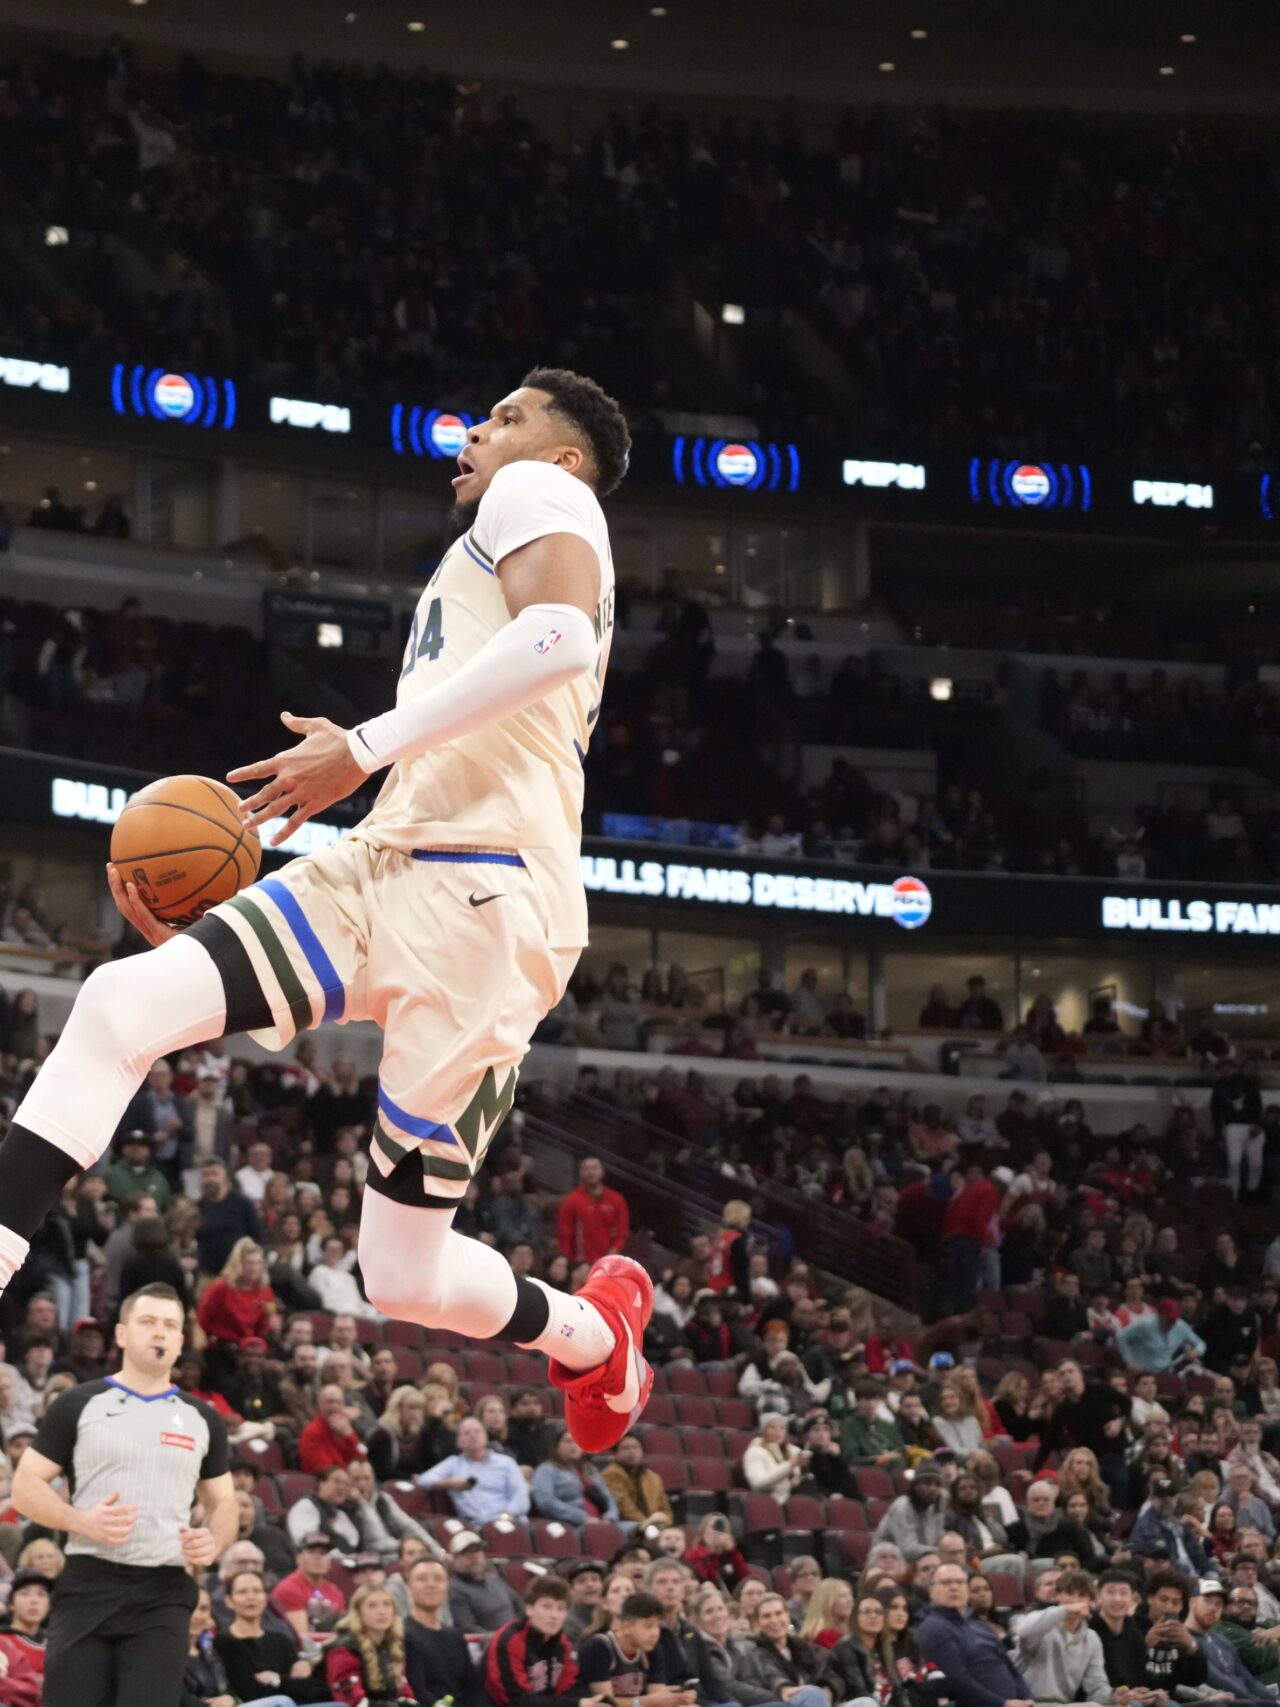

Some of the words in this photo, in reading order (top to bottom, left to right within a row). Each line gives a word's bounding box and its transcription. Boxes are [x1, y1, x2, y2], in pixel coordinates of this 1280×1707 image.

[271, 398, 350, 432] PEPSI
[844, 460, 925, 489] PEPSI
[1134, 481, 1212, 508] PEPSI
[52, 778, 137, 825] BULL
[582, 856, 665, 896] ULLS
[666, 864, 752, 904] FANS
[752, 872, 892, 917] DESERVE
[1102, 896, 1214, 932] BULLS
[1215, 901, 1280, 935] FAN
